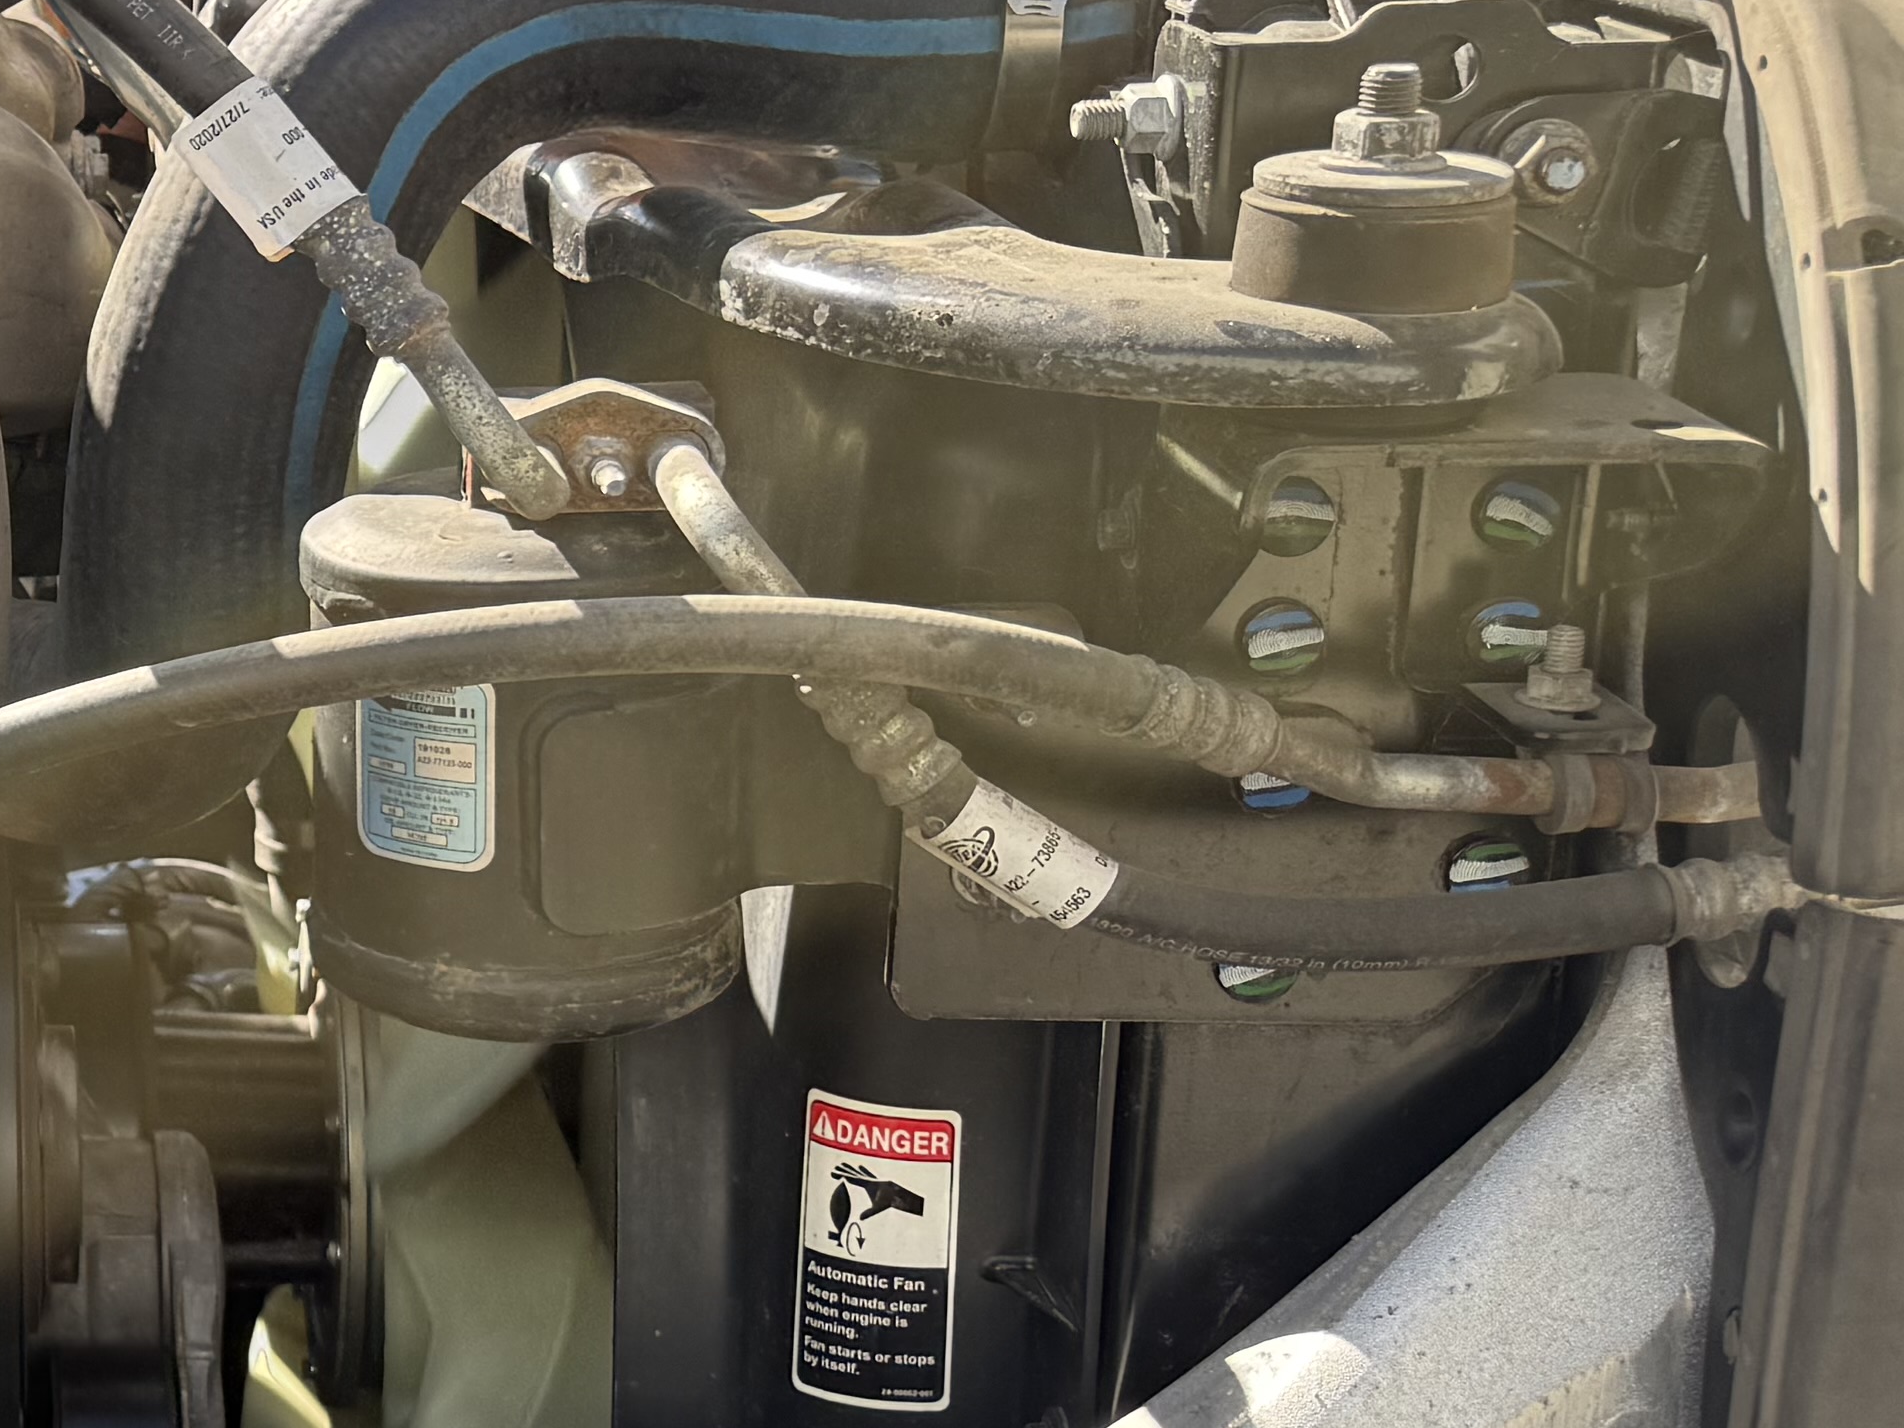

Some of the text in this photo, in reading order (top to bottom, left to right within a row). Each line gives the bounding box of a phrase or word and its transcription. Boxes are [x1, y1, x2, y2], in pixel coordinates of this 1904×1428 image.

[188, 100, 251, 152] 7/27/2020
[283, 187, 306, 209] the
[304, 176, 322, 192] in
[256, 204, 286, 230] USA
[1180, 943, 1246, 963] HOSE
[1332, 956, 1409, 971] (10mm)
[837, 1119, 950, 1156] DANGER
[807, 1260, 926, 1291] Automatic Fan
[806, 1282, 928, 1313] Keep hands clear
[805, 1300, 909, 1328] when engine is
[805, 1315, 859, 1340] running.
[803, 1350, 861, 1375] by itself.
[804, 1335, 936, 1367] Fan starts or stops
